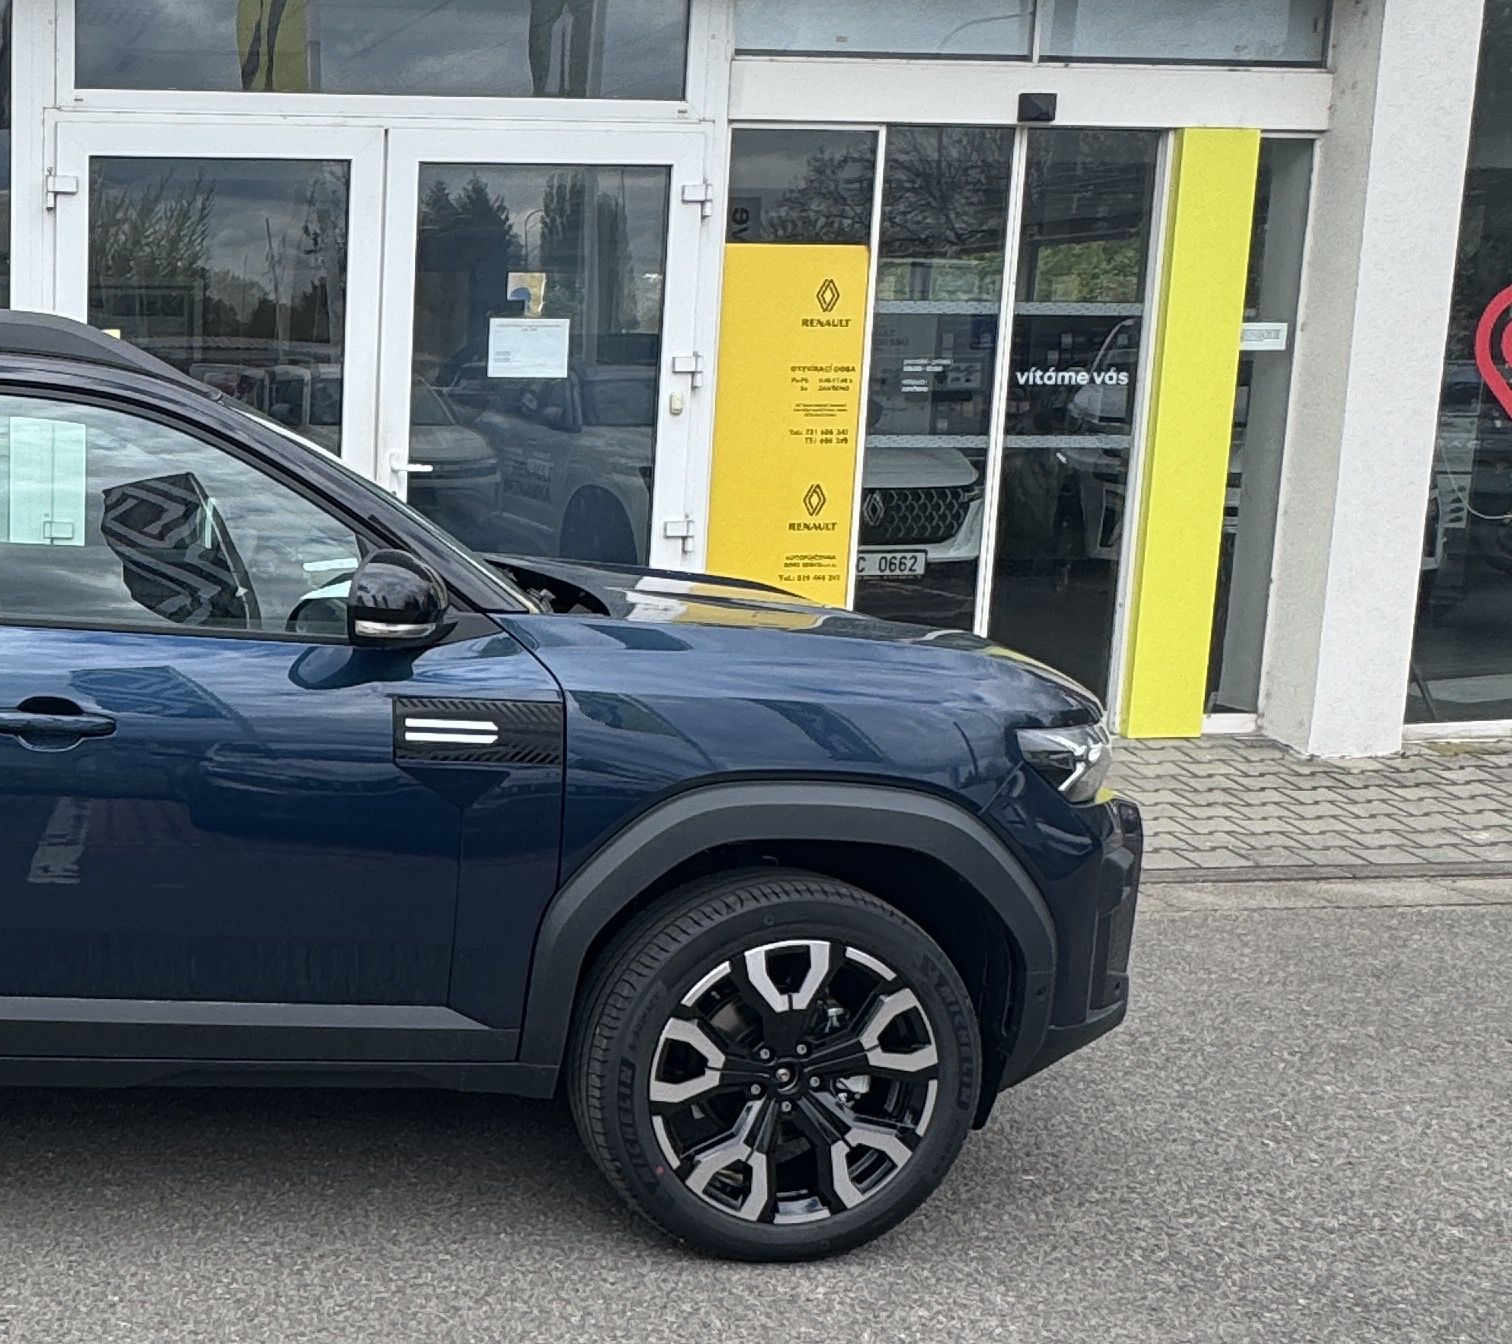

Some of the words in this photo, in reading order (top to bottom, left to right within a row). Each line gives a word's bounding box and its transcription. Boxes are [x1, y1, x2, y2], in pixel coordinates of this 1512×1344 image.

[801, 318, 852, 328] RENAULT
[1016, 366, 1090, 385] vítáme
[1092, 366, 1129, 385] vás
[788, 522, 838, 531] RENAULT
[879, 555, 918, 573] 0662
